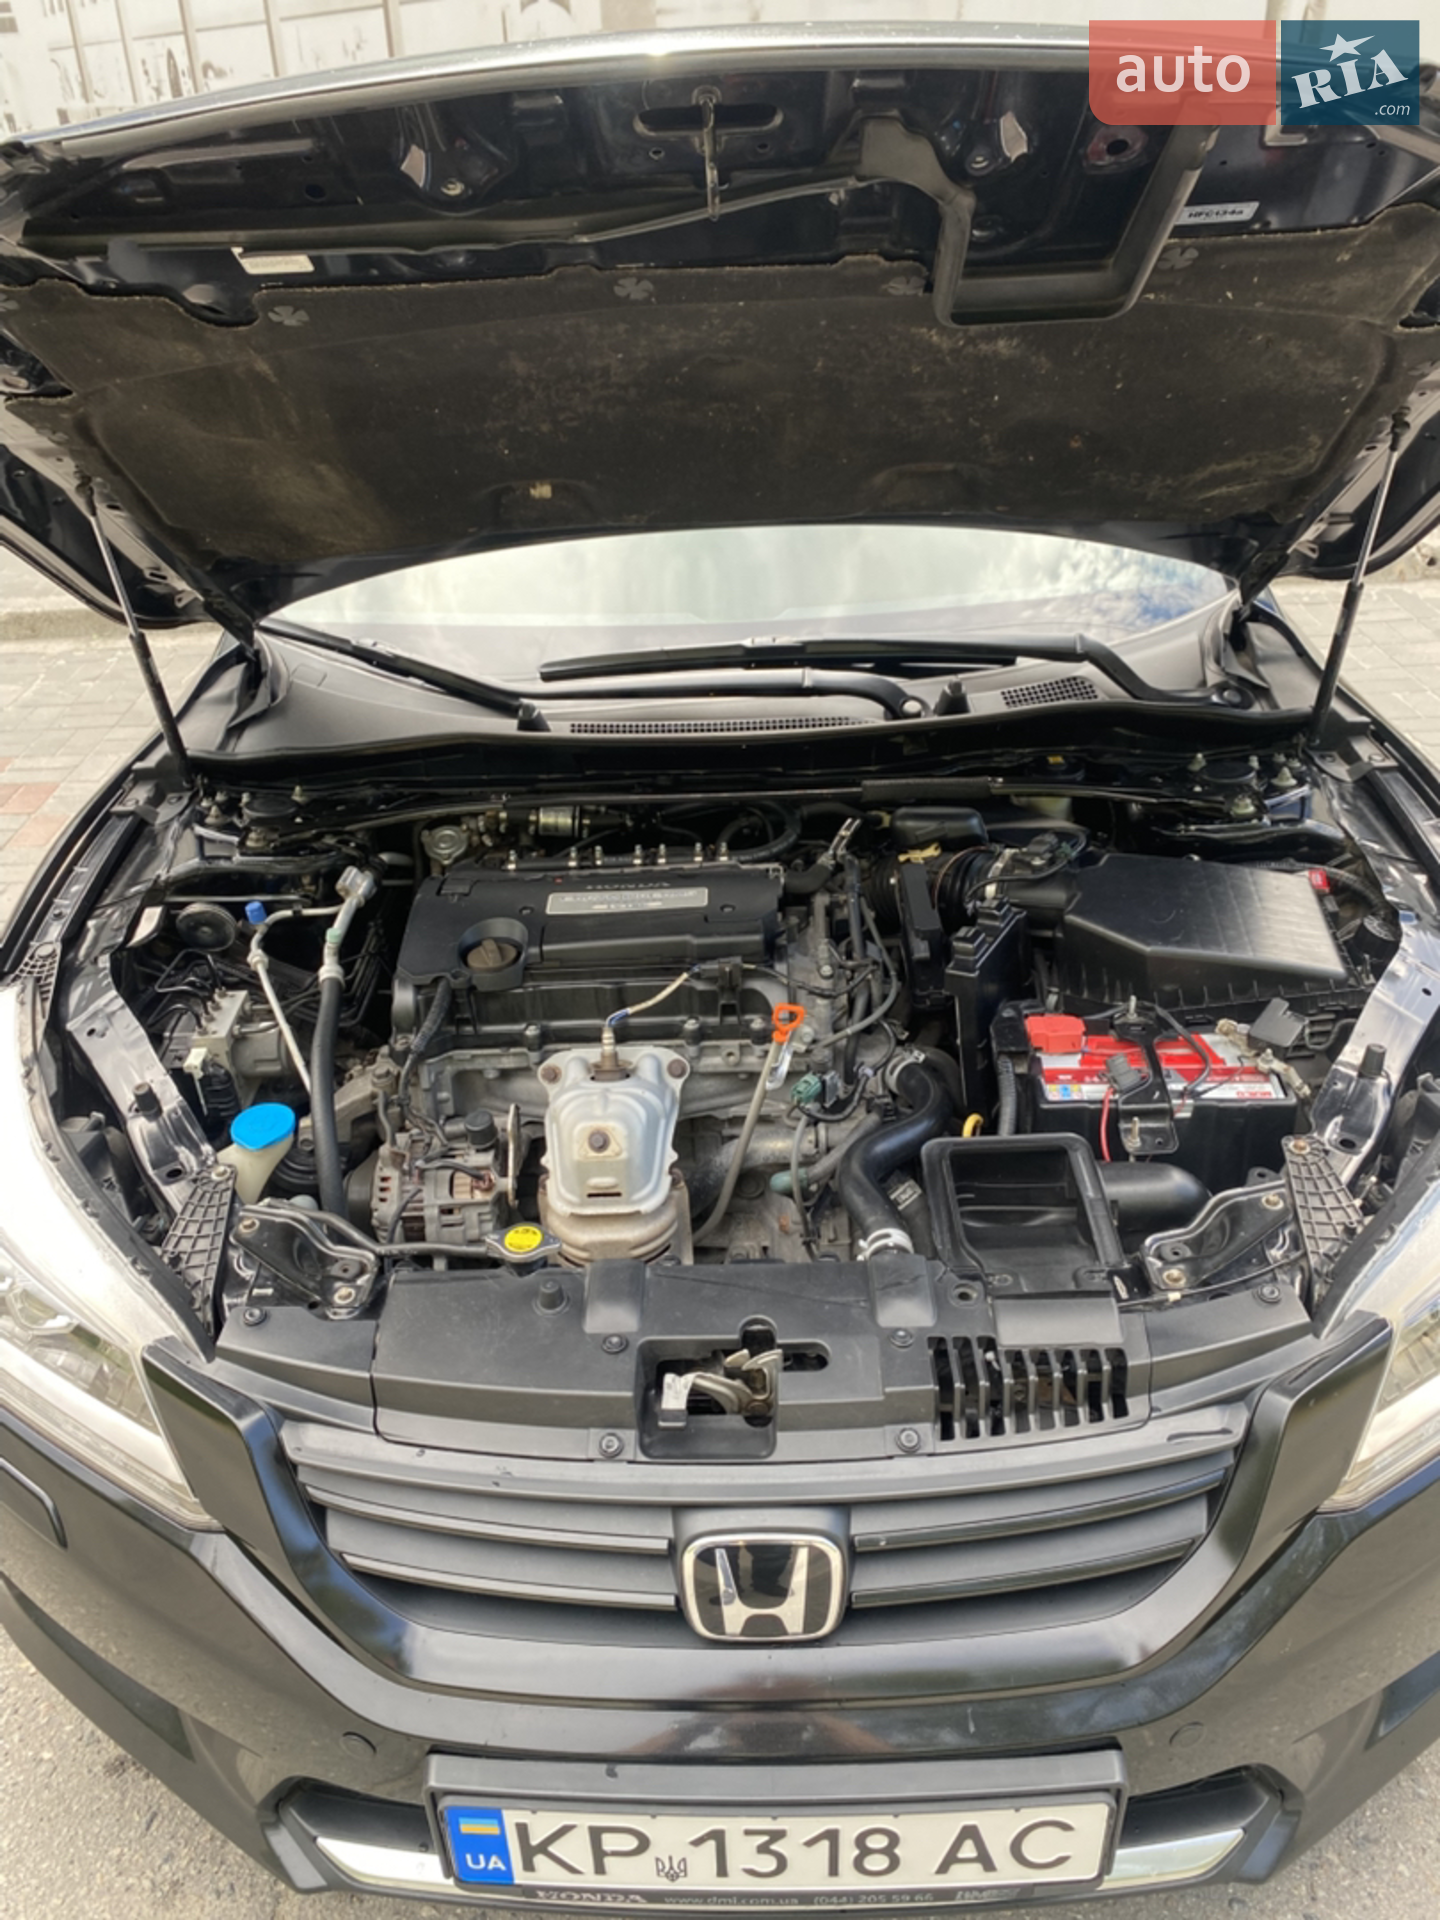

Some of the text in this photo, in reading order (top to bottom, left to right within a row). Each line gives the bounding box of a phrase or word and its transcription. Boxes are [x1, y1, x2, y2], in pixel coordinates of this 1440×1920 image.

[514, 1818, 1077, 1878] KP 1318 AC
[465, 1852, 507, 1872] UA
[535, 1889, 649, 1904] HONDA
